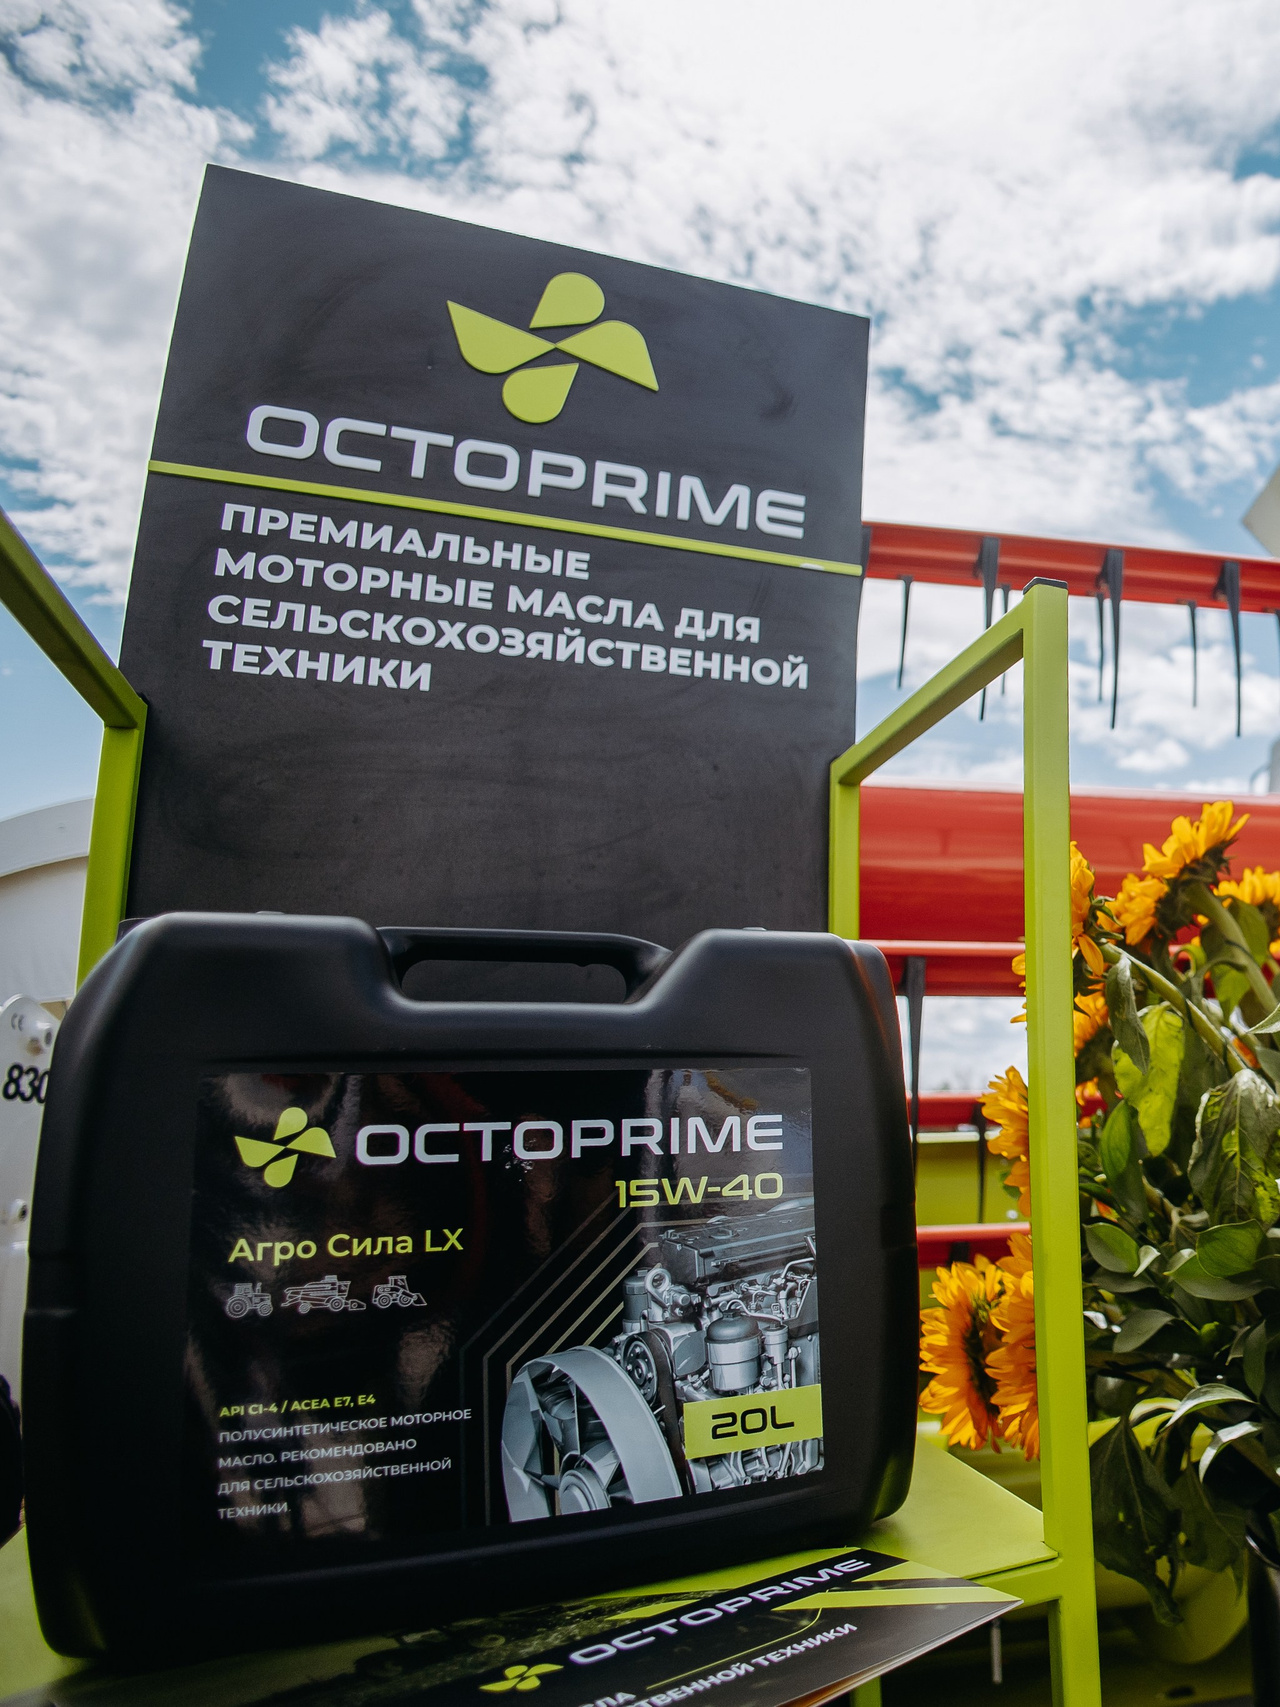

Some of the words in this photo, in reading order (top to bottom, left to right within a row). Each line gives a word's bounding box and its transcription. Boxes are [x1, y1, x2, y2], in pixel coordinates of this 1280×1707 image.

[246, 404, 807, 539] OCTOPRIME
[221, 502, 591, 581] ПРЕМИАЛЬНЫЕ
[214, 547, 494, 611] МОТОРНЫЕ
[507, 584, 665, 633] МАСЛА
[674, 607, 761, 644] ДЛЯ
[207, 594, 809, 690] СЕЛЬСКОХОЗЯЙСТВЕННОЙ
[202, 639, 432, 692] ТЕХНИКИ
[356, 1113, 785, 1166] OCTOPRIME
[615, 1172, 783, 1208] 15W-40
[228, 1238, 317, 1267] Агро
[327, 1233, 413, 1257] Сила
[425, 1228, 464, 1252] LX
[219, 1405, 245, 1418] API
[248, 1402, 278, 1416] CI-4
[281, 1400, 288, 1413] /
[290, 1398, 330, 1412] ACEA
[334, 1396, 354, 1408] E7,
[358, 1394, 376, 1406] E4
[219, 1417, 387, 1443] ПОЛУСИНТЕТИЧЕСКОЕ
[391, 1408, 472, 1427] МОТОРНОЕ
[711, 1405, 795, 1441] 20L
[217, 1480, 250, 1496] ДЛЯ
[254, 1456, 452, 1491] СЕЛЬСКОХОЗЯЙСТВЕННОЙ
[219, 1453, 277, 1469] МАСЛО.
[281, 1438, 417, 1463] РЕКОМЕНДОВАНО
[218, 1501, 291, 1520] ТЕХНИКИ.
[568, 1558, 872, 1666] OCTOPRIME
[626, 1661, 755, 1707] ТВЕННОЙ
[751, 1622, 858, 1668] ТЕХНИКИ
